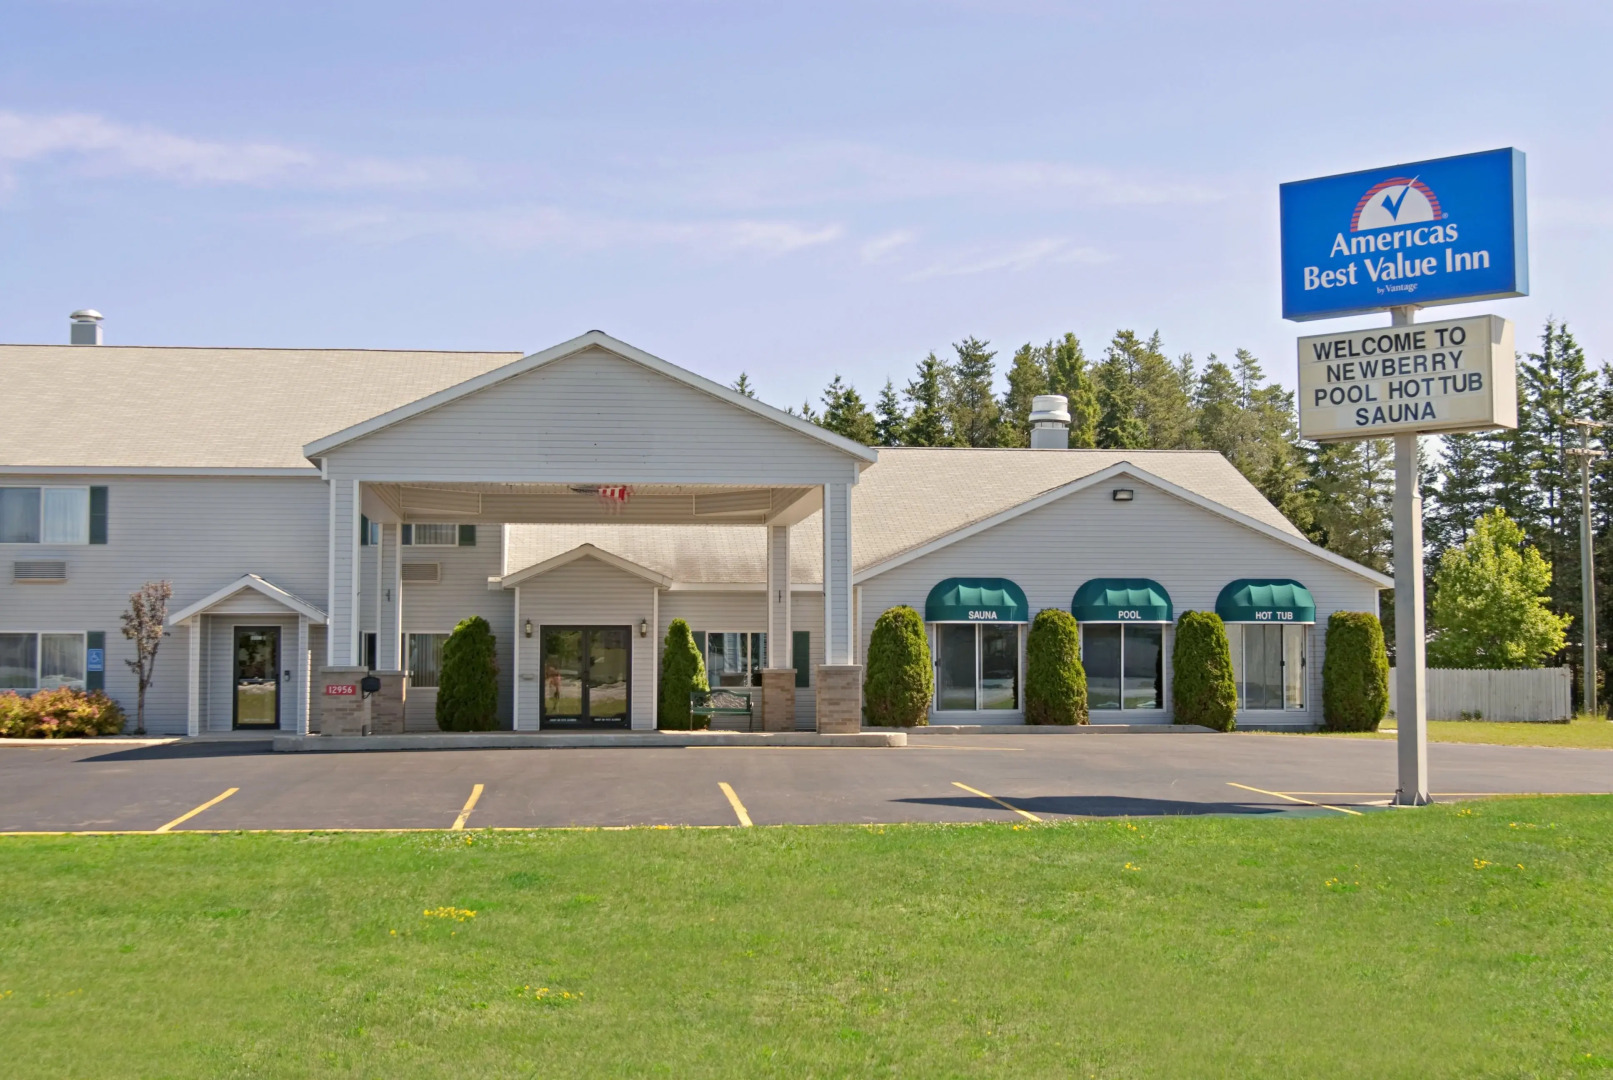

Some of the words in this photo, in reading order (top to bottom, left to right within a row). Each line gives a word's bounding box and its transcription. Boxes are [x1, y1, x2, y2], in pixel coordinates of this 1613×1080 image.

[1329, 223, 1459, 258] Americas
[1303, 262, 1358, 291] Best
[1364, 252, 1437, 282] Value
[1445, 248, 1490, 273] Inn
[1376, 287, 1385, 295] by
[1385, 282, 1418, 293] Vantage
[1313, 331, 1426, 361] WELCOME
[1434, 326, 1466, 347] TO
[1326, 350, 1463, 383] NEWBERRY
[1314, 384, 1377, 407] POOL
[1355, 401, 1436, 426] SAUNA
[968, 610, 998, 620] SAUNA
[1118, 610, 1142, 619] POOL
[1255, 611, 1273, 620] HOT
[1276, 611, 1293, 620] TUB
[328, 685, 353, 694] 12956
